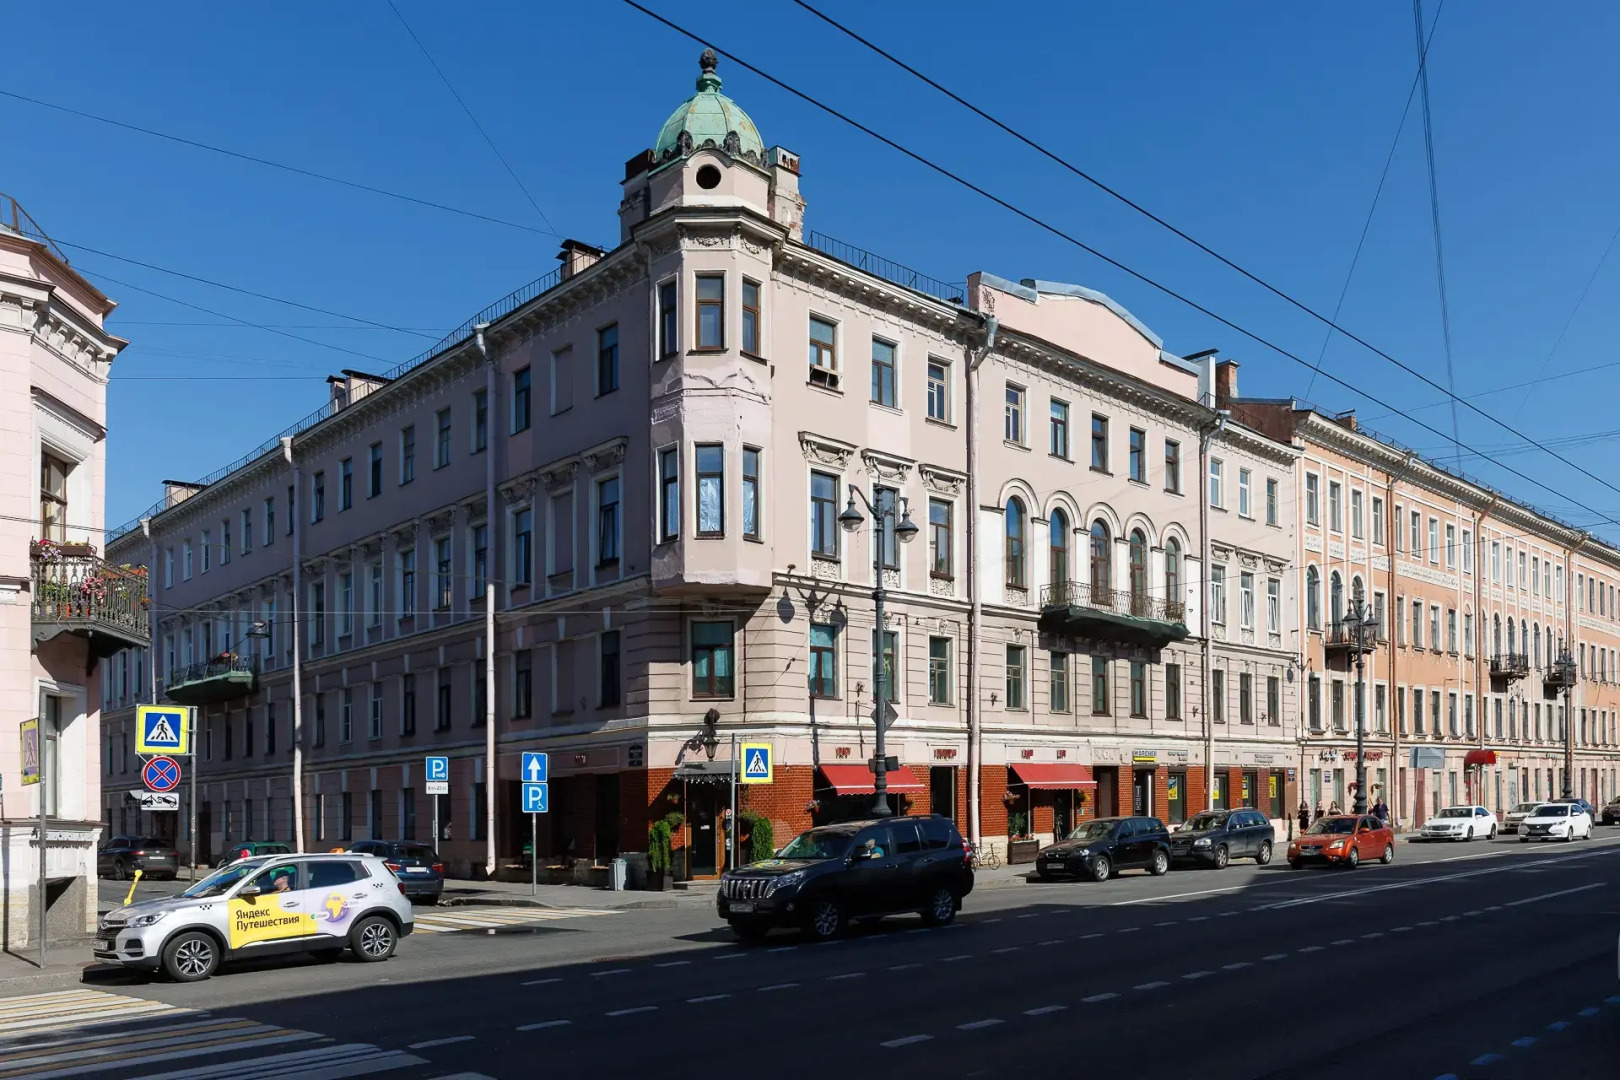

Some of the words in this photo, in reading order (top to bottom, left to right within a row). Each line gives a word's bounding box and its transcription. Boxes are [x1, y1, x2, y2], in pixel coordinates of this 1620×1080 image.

[432, 759, 444, 778] P
[528, 786, 543, 809] P
[236, 908, 271, 920] Яндекс
[236, 916, 300, 932] Путешествия
